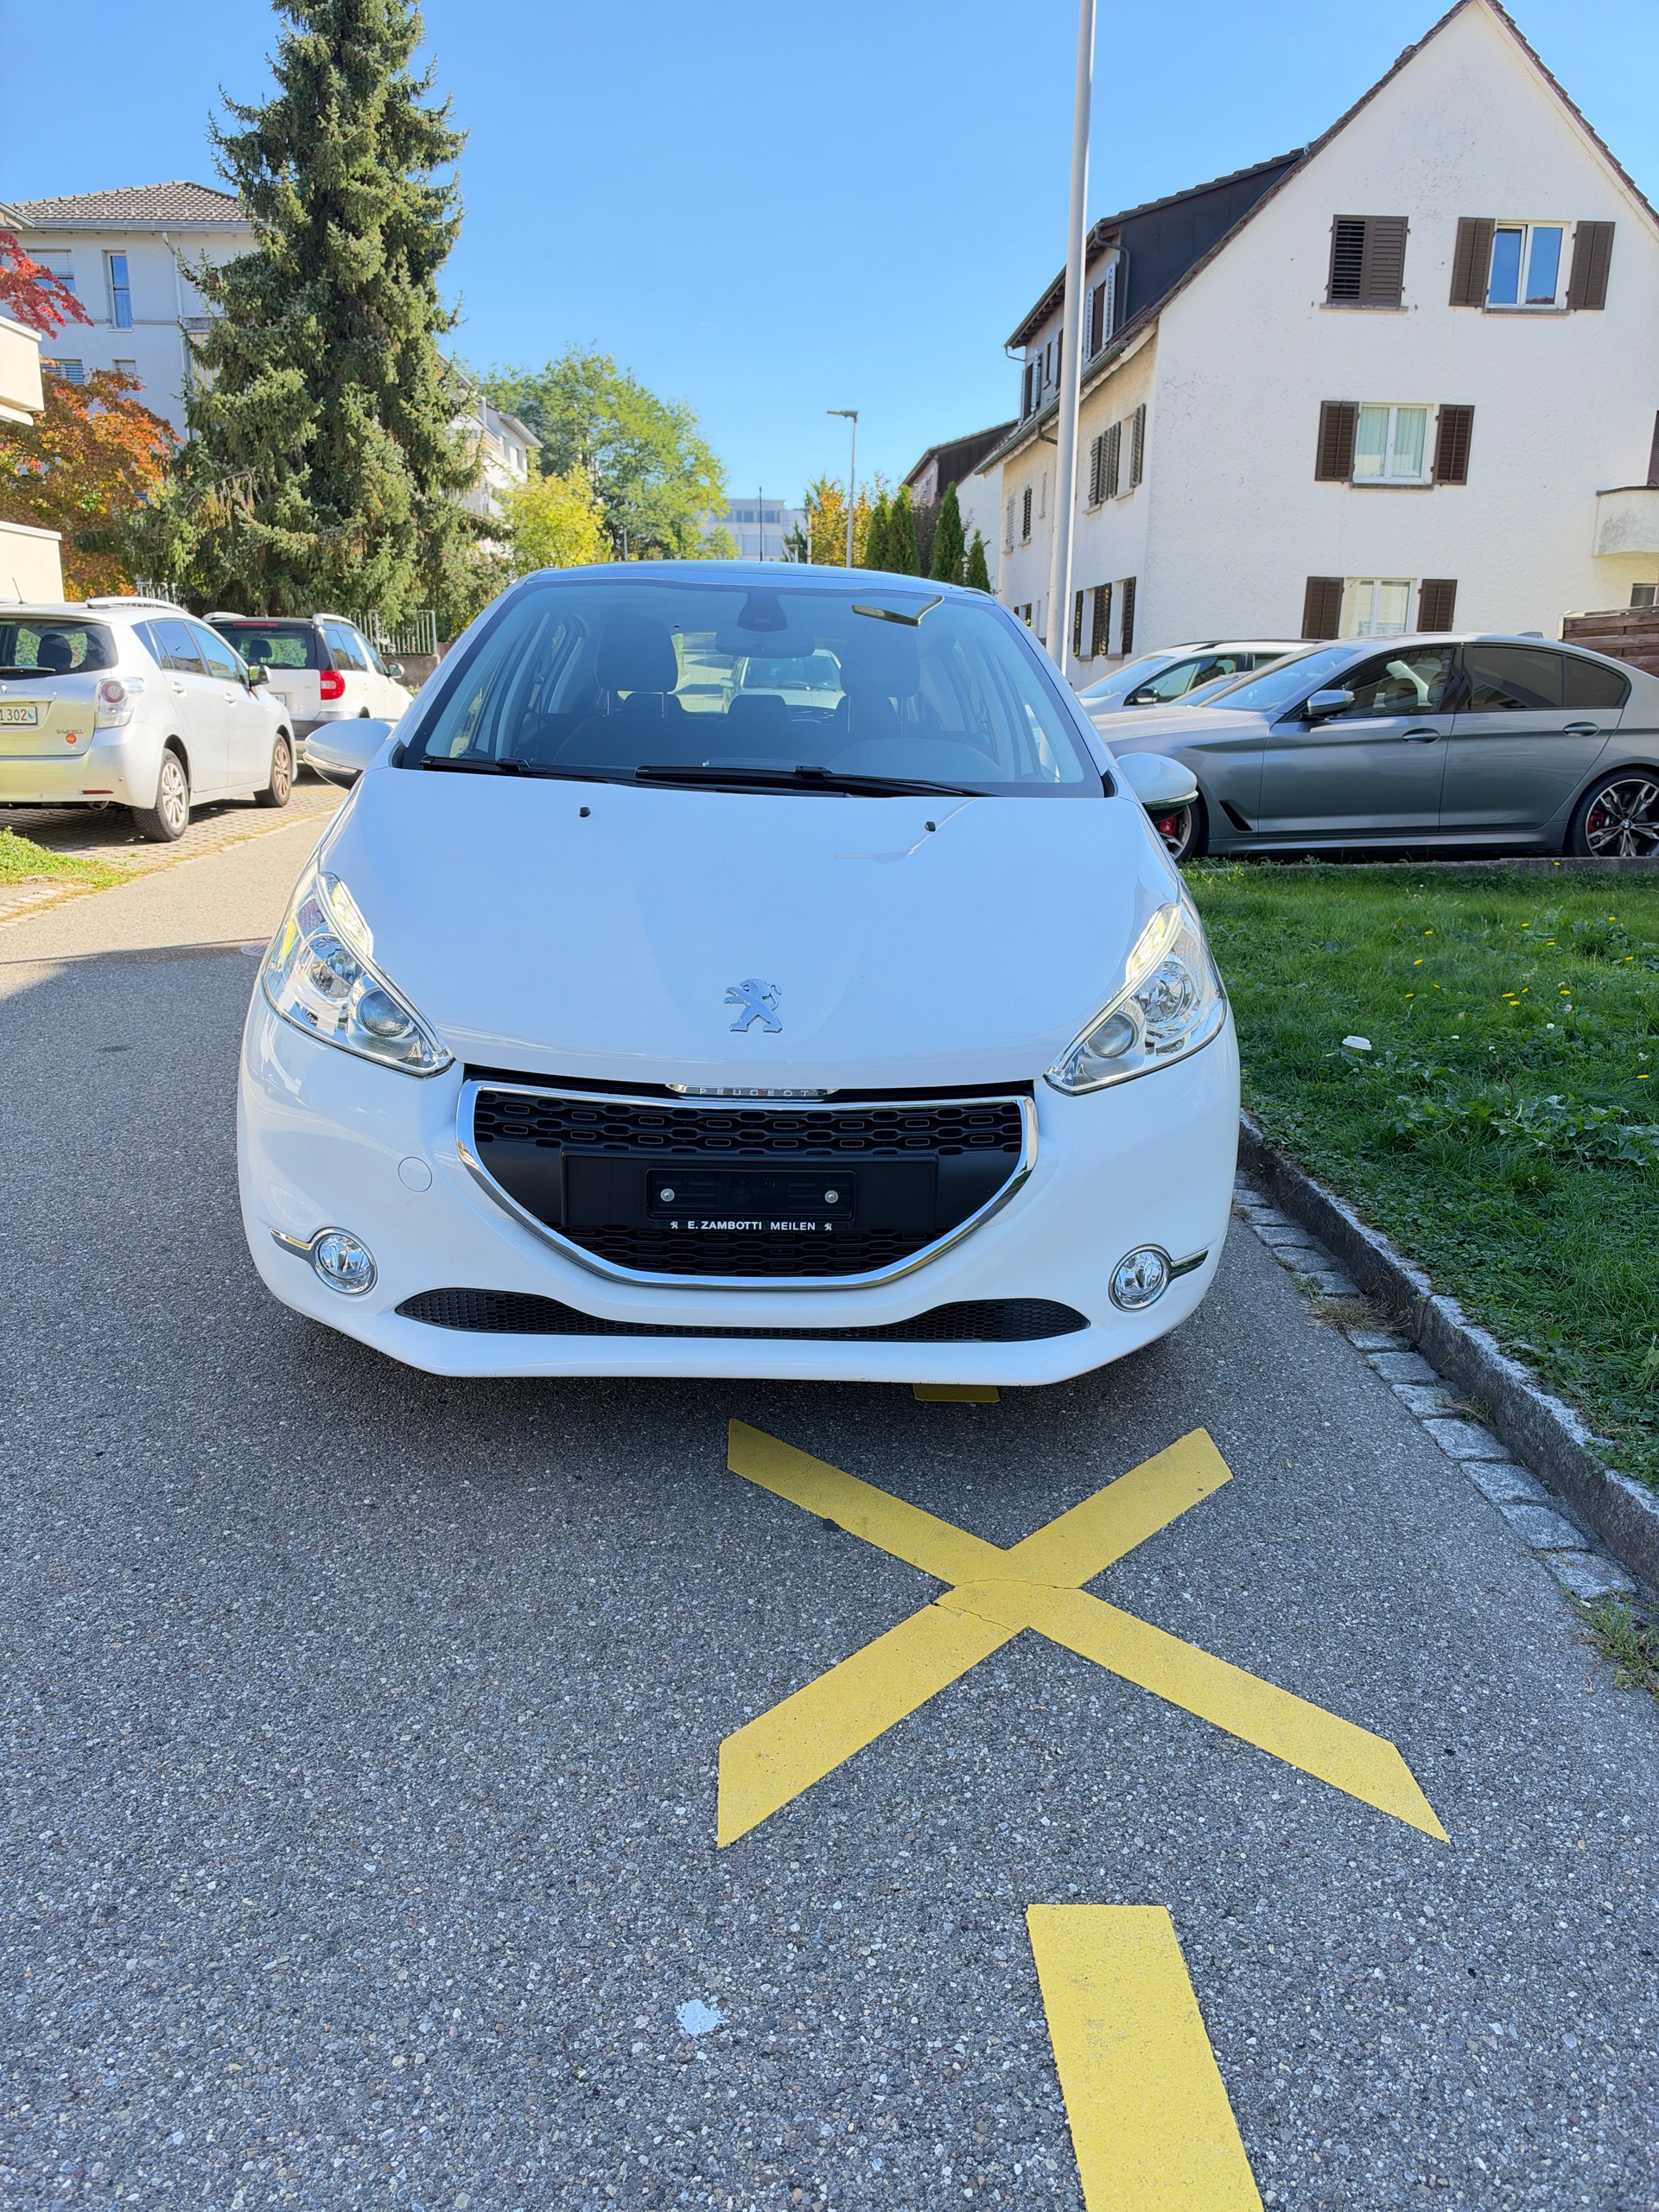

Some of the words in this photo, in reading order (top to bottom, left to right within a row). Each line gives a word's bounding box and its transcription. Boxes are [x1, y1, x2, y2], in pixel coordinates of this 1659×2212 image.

[699, 1087, 810, 1097] PEUGEOT
[687, 1220, 699, 1230] E.
[700, 1220, 762, 1230] ZAMBOTTI
[770, 1221, 816, 1231] MEILEN
